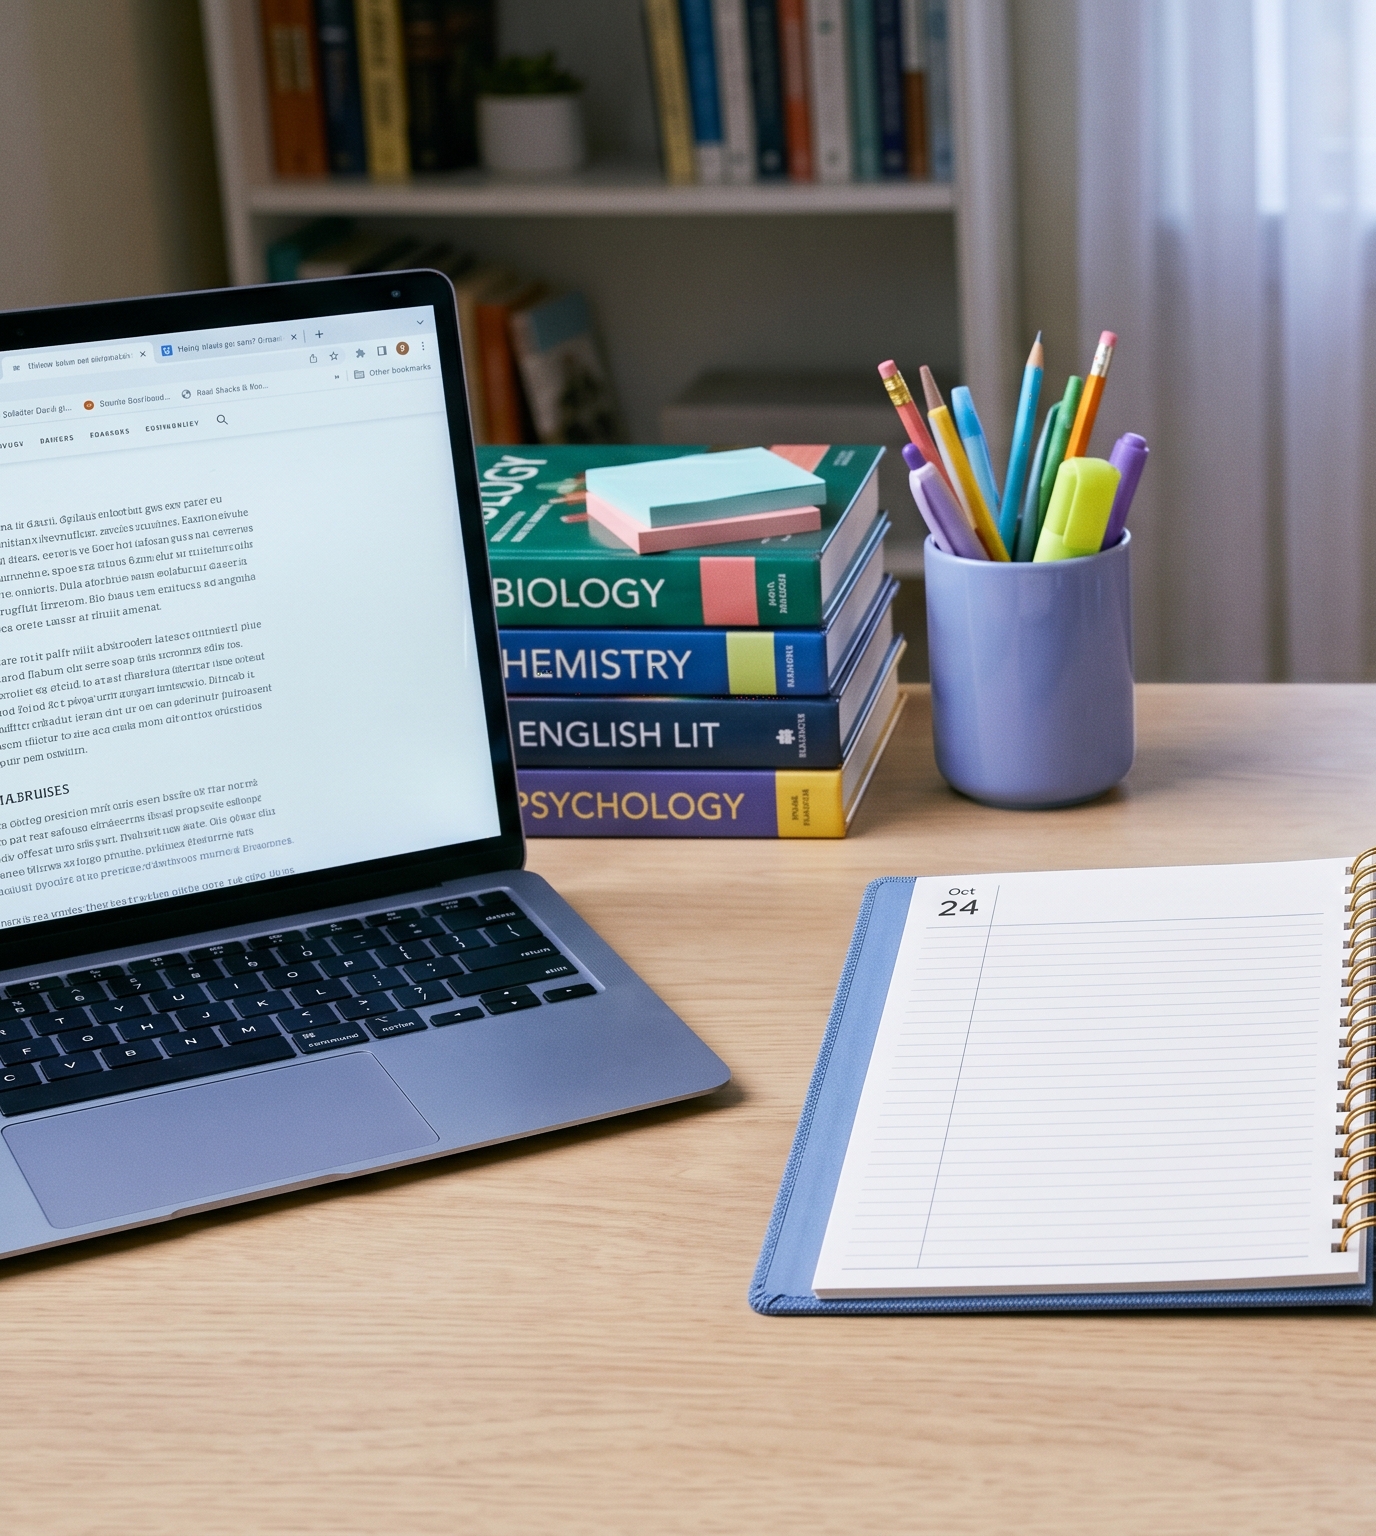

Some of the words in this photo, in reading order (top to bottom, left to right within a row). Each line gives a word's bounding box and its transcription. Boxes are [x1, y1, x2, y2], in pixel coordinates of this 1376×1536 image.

[369, 368, 390, 377] Other
[392, 363, 431, 374] bookmarks
[480, 454, 548, 526] LOGY
[210, 496, 222, 505] eu
[492, 577, 665, 609] BIOLOGY
[89, 594, 106, 604] Bio
[112, 655, 135, 667] soap
[502, 648, 692, 680] HEMISTRY
[156, 700, 172, 709] can
[518, 721, 661, 748] ENGLISH
[674, 722, 720, 748] LIT
[23, 753, 44, 764] pem
[10, 835, 26, 846] pat
[948, 887, 976, 896] Oct
[938, 899, 979, 916] 24
[202, 1011, 211, 1019] J
[54, 1017, 65, 1025] T
[241, 1025, 257, 1033] M
[185, 1037, 197, 1045] N
[22, 1047, 32, 1055] F
[64, 1061, 76, 1069] V
[3, 1074, 16, 1082] C
